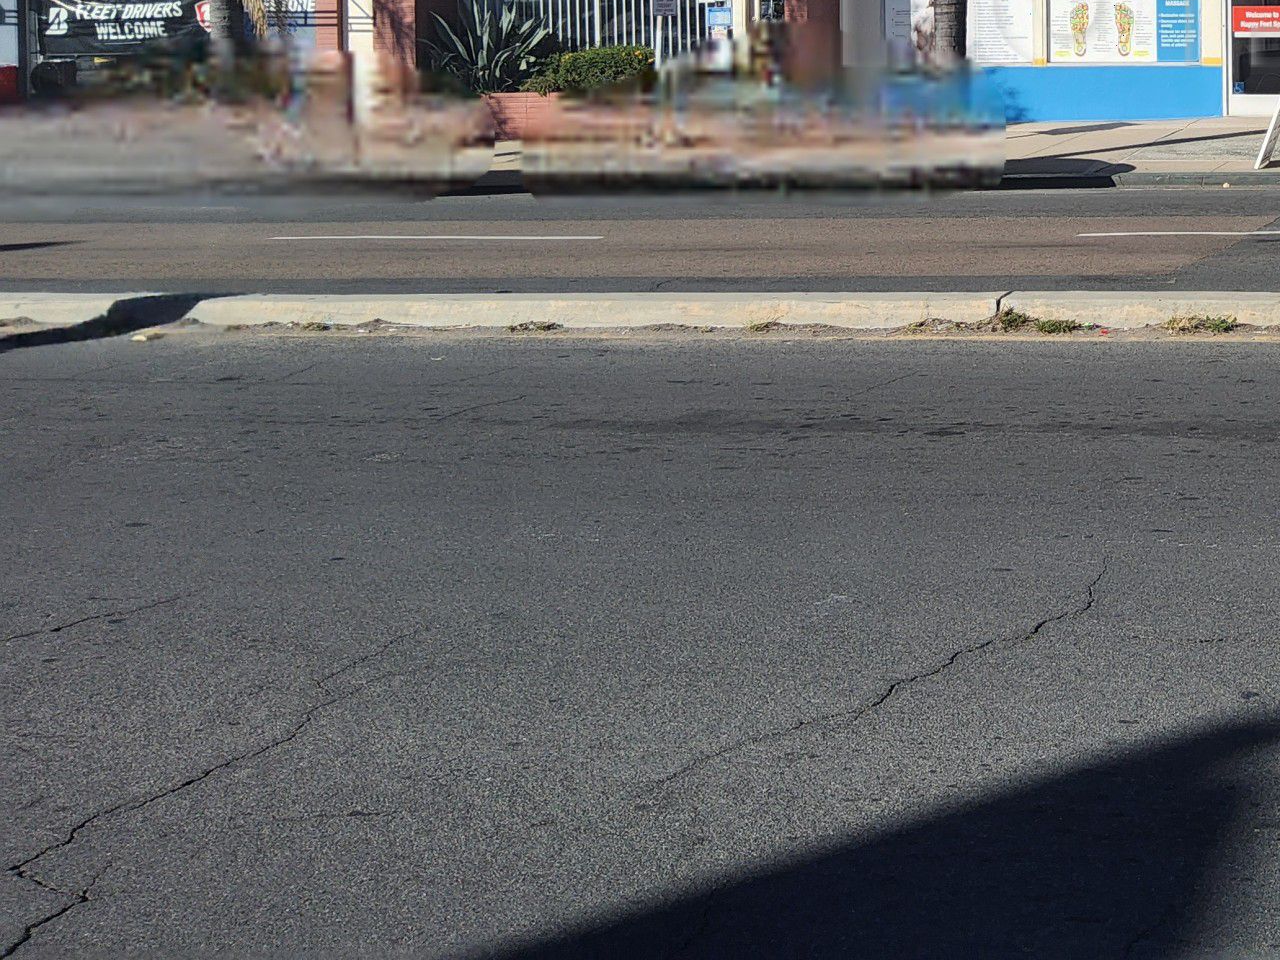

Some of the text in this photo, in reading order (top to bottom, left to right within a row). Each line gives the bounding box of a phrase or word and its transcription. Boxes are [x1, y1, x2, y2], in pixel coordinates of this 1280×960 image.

[75, 0, 183, 20] FLEET DRIVERS
[94, 20, 169, 40] WELCOME
[1240, 20, 1259, 29] Happy
[1259, 20, 1273, 28] Feet
